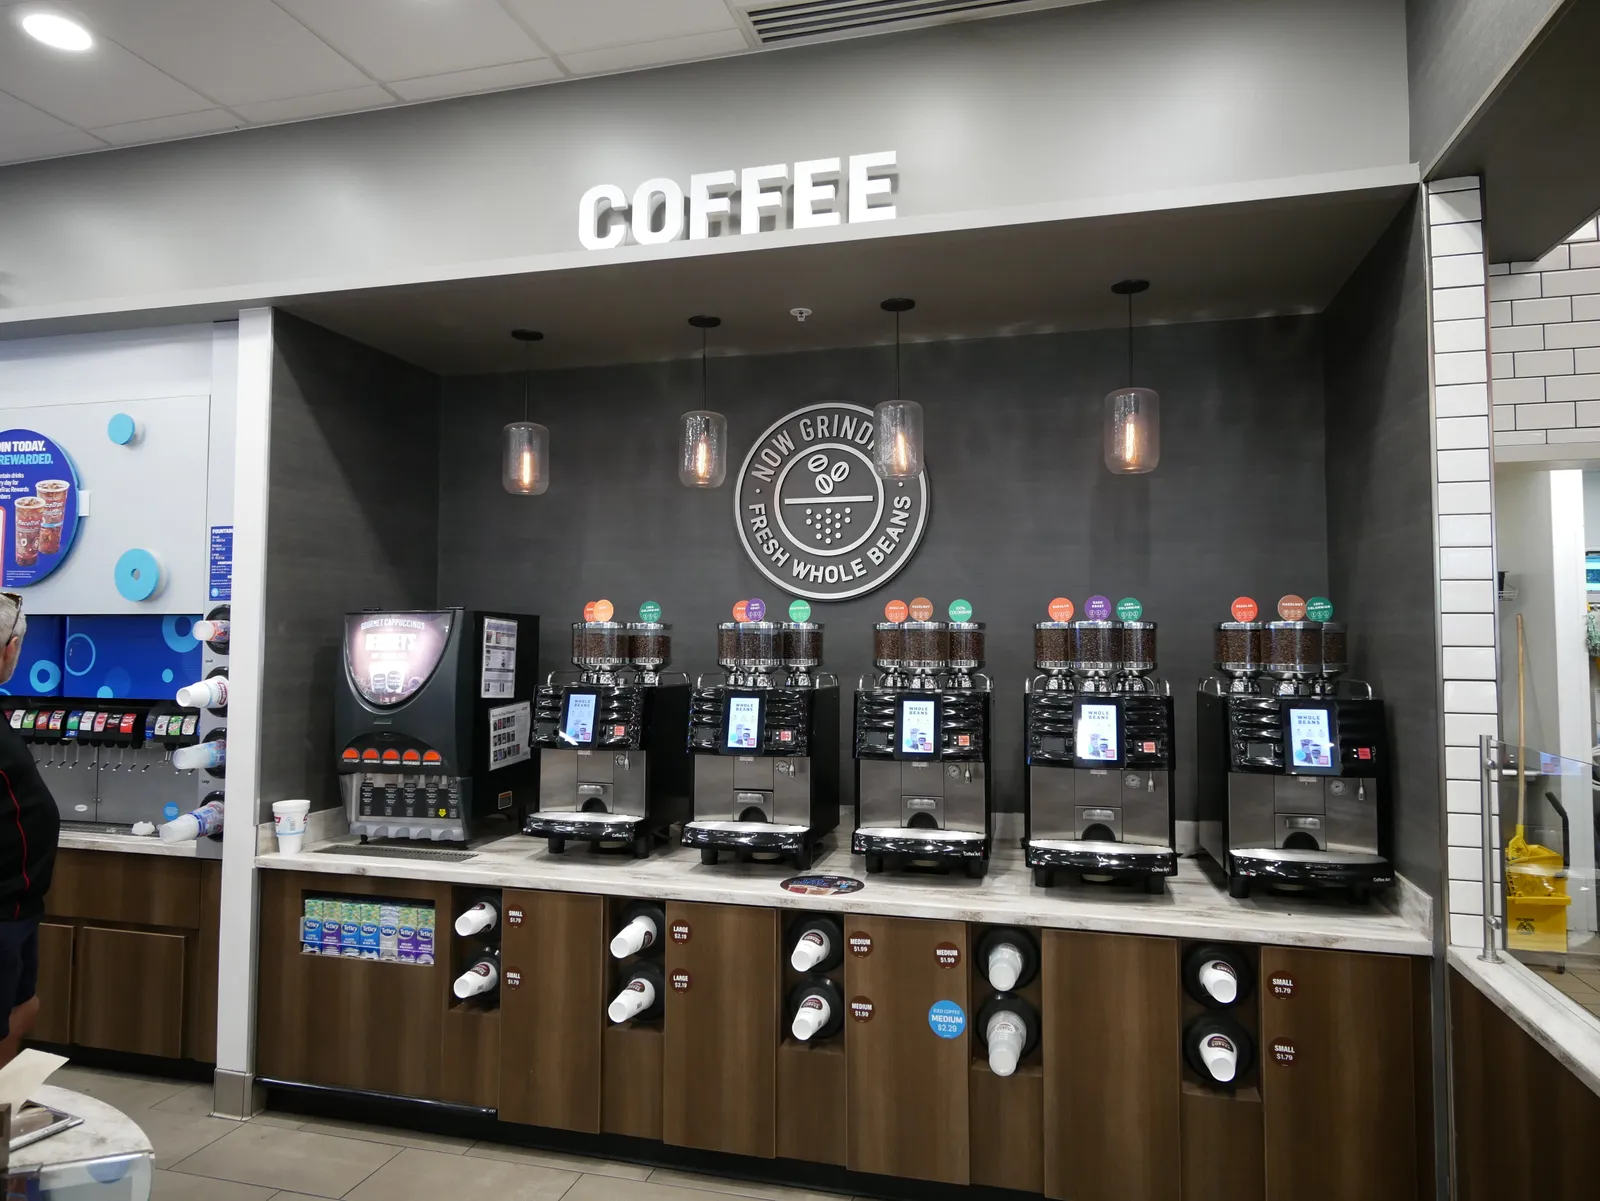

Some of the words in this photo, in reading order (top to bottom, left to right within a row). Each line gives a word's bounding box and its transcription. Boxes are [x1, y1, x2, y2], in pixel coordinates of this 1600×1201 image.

[579, 151, 896, 250] COFFEE
[0, 442, 11, 452] IN
[12, 440, 46, 452] TODAY.
[752, 430, 795, 482] NOW
[800, 414, 874, 450] GRIND
[749, 503, 791, 567] FRESH
[792, 558, 867, 584] WHOLE
[866, 496, 912, 566] BEANS
[384, 618, 424, 629] CAPPUCCINOS
[932, 1015, 962, 1024] MEDIUM
[938, 1024, 957, 1032] $2.29
[1274, 1045, 1295, 1053] SMALL
